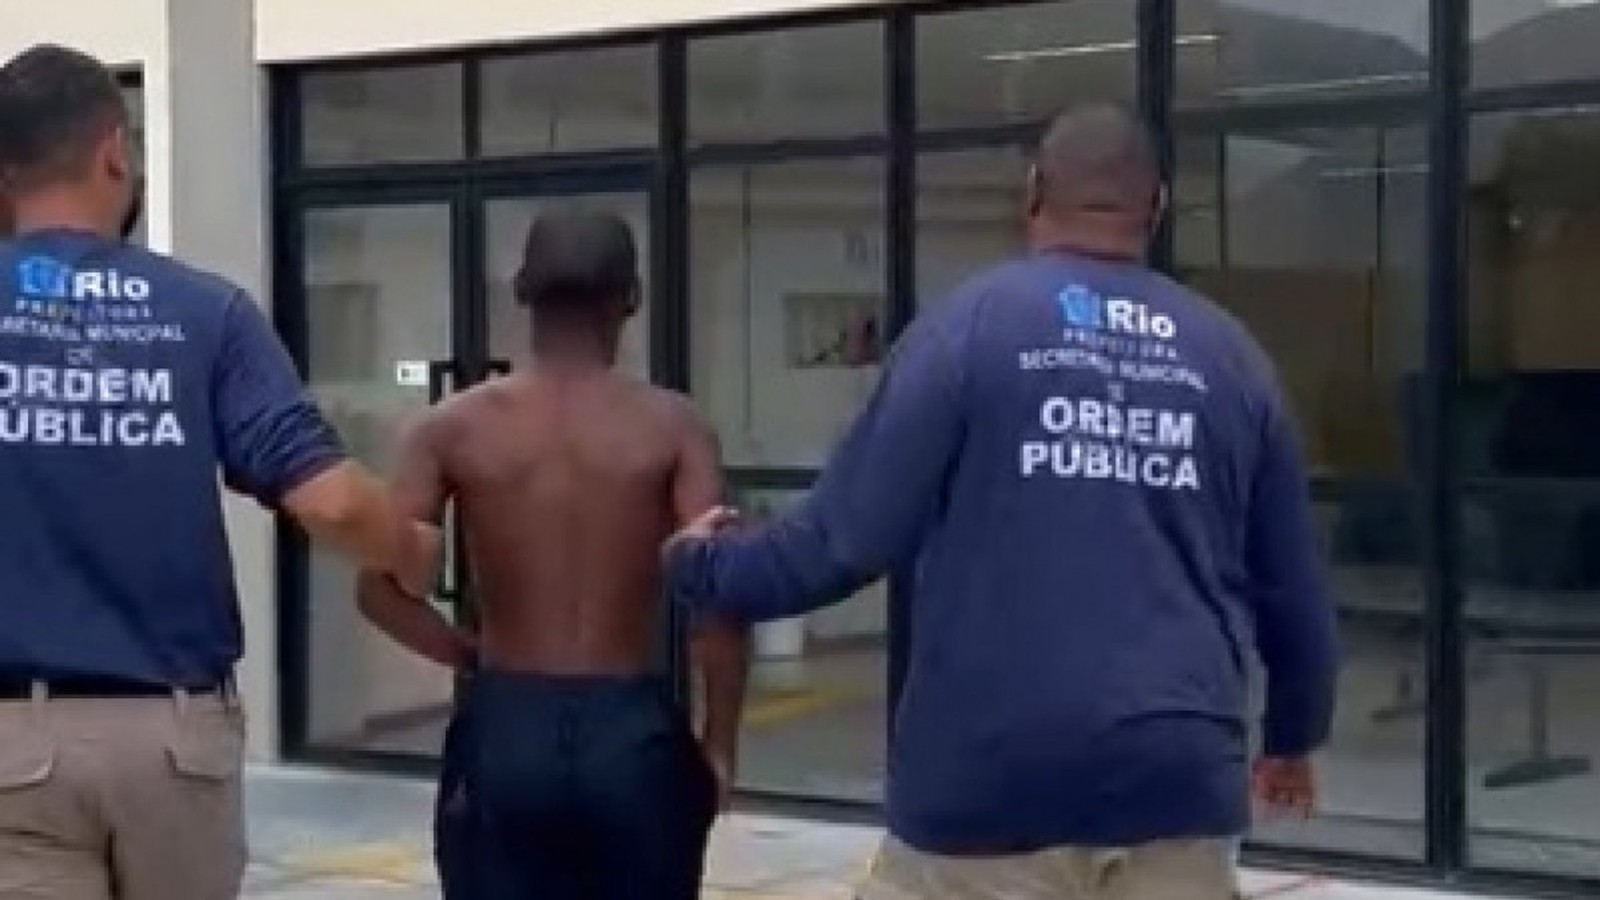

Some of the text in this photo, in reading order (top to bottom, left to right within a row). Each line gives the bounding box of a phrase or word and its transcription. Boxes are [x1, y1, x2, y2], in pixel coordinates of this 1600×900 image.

[74, 270, 149, 300] Rio
[1106, 298, 1176, 338] Rio
[0, 364, 170, 403] ORDEM
[1041, 396, 1195, 448] ORDEM
